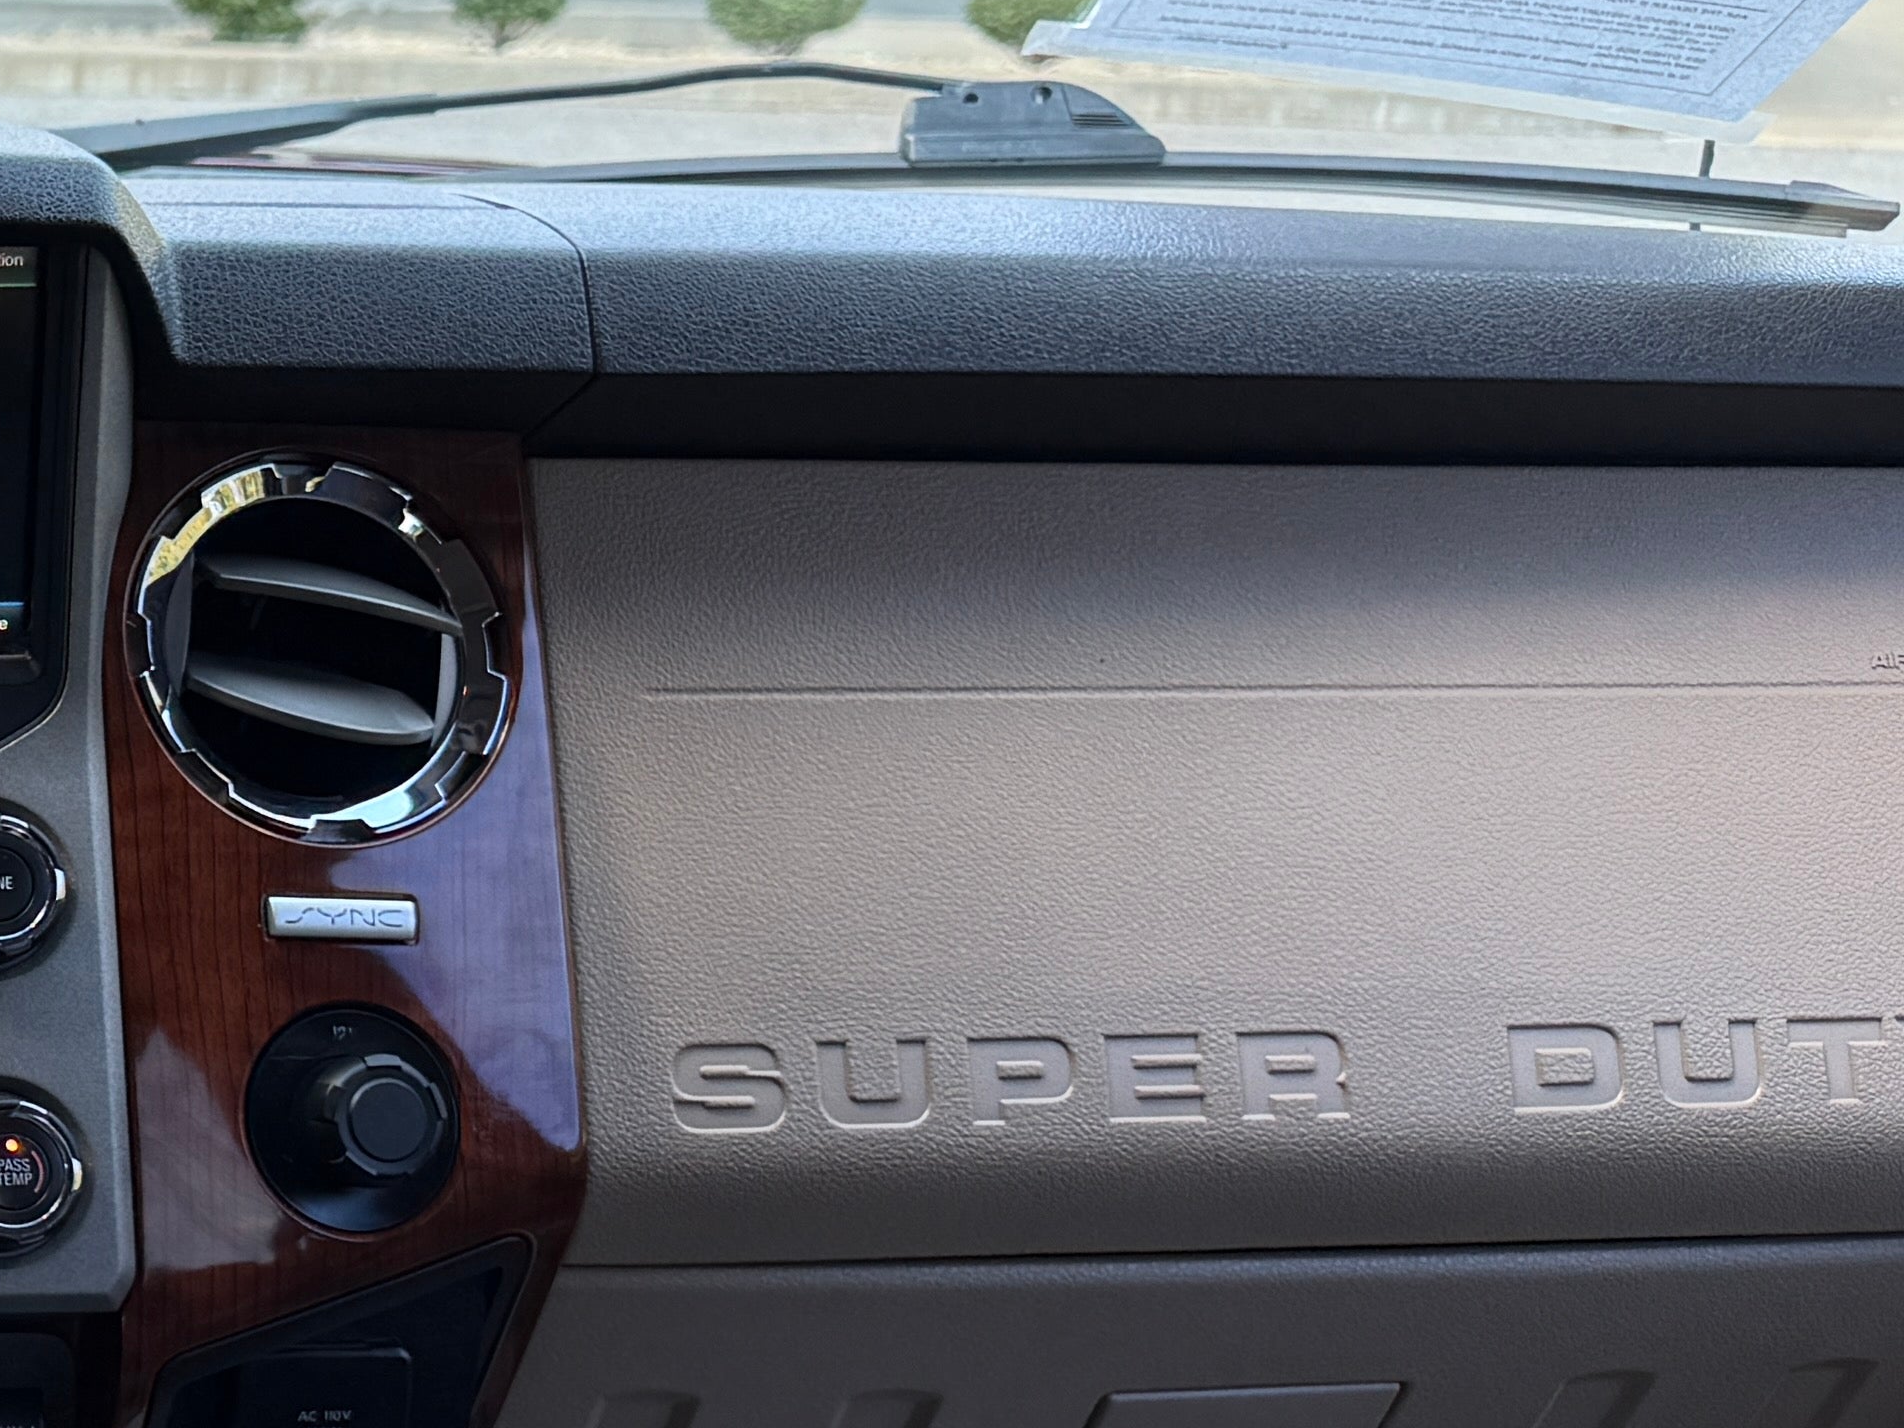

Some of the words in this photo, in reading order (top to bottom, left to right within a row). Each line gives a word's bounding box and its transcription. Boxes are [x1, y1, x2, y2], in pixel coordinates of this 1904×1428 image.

[284, 907, 405, 929] SYNC
[669, 1029, 1352, 1134] SUPER
[1505, 1013, 1904, 1115] DUT
